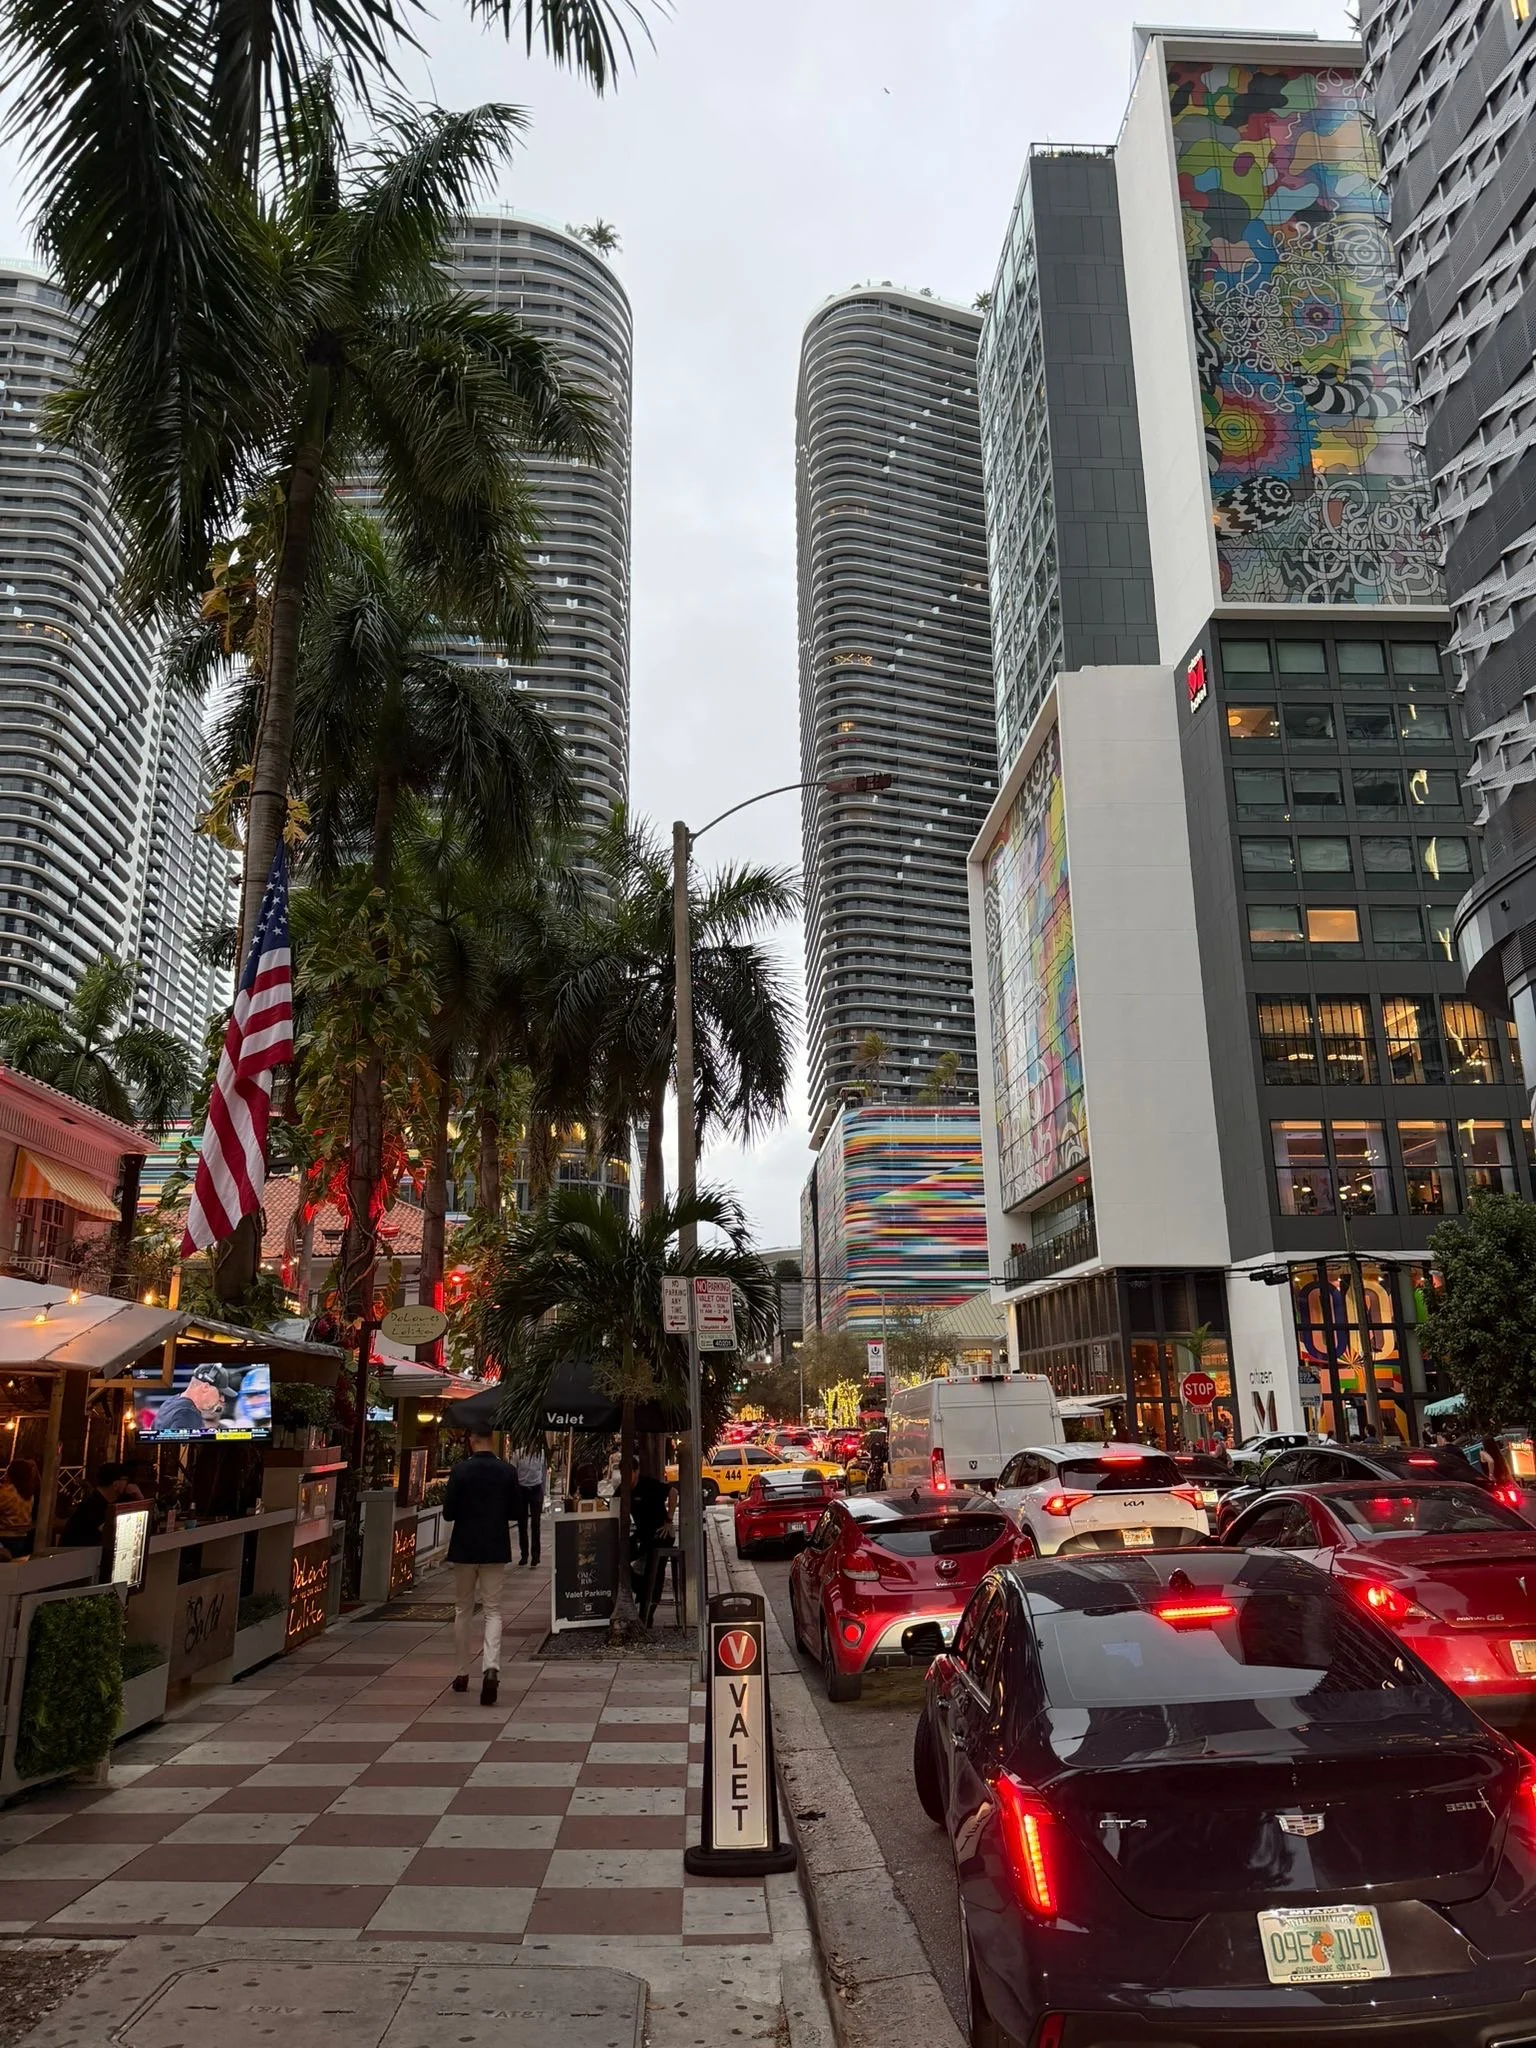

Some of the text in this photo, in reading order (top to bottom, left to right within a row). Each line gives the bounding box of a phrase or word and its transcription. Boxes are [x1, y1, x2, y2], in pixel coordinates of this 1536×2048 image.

[671, 1280, 679, 1288] NO
[696, 1280, 729, 1293] NO PARKING
[665, 1288, 687, 1297] PARKING
[671, 1297, 681, 1305] ANY
[671, 1306, 683, 1314] TIME
[1185, 1382, 1214, 1396] STOP
[547, 1411, 585, 1425] Valet
[725, 1470, 742, 1481] 444
[565, 1589, 612, 1599] Valet Parking
[728, 1635, 748, 1664] V
[729, 1683, 749, 1831] VALET
[1291, 1972, 1369, 1981] WILLIAMSON
